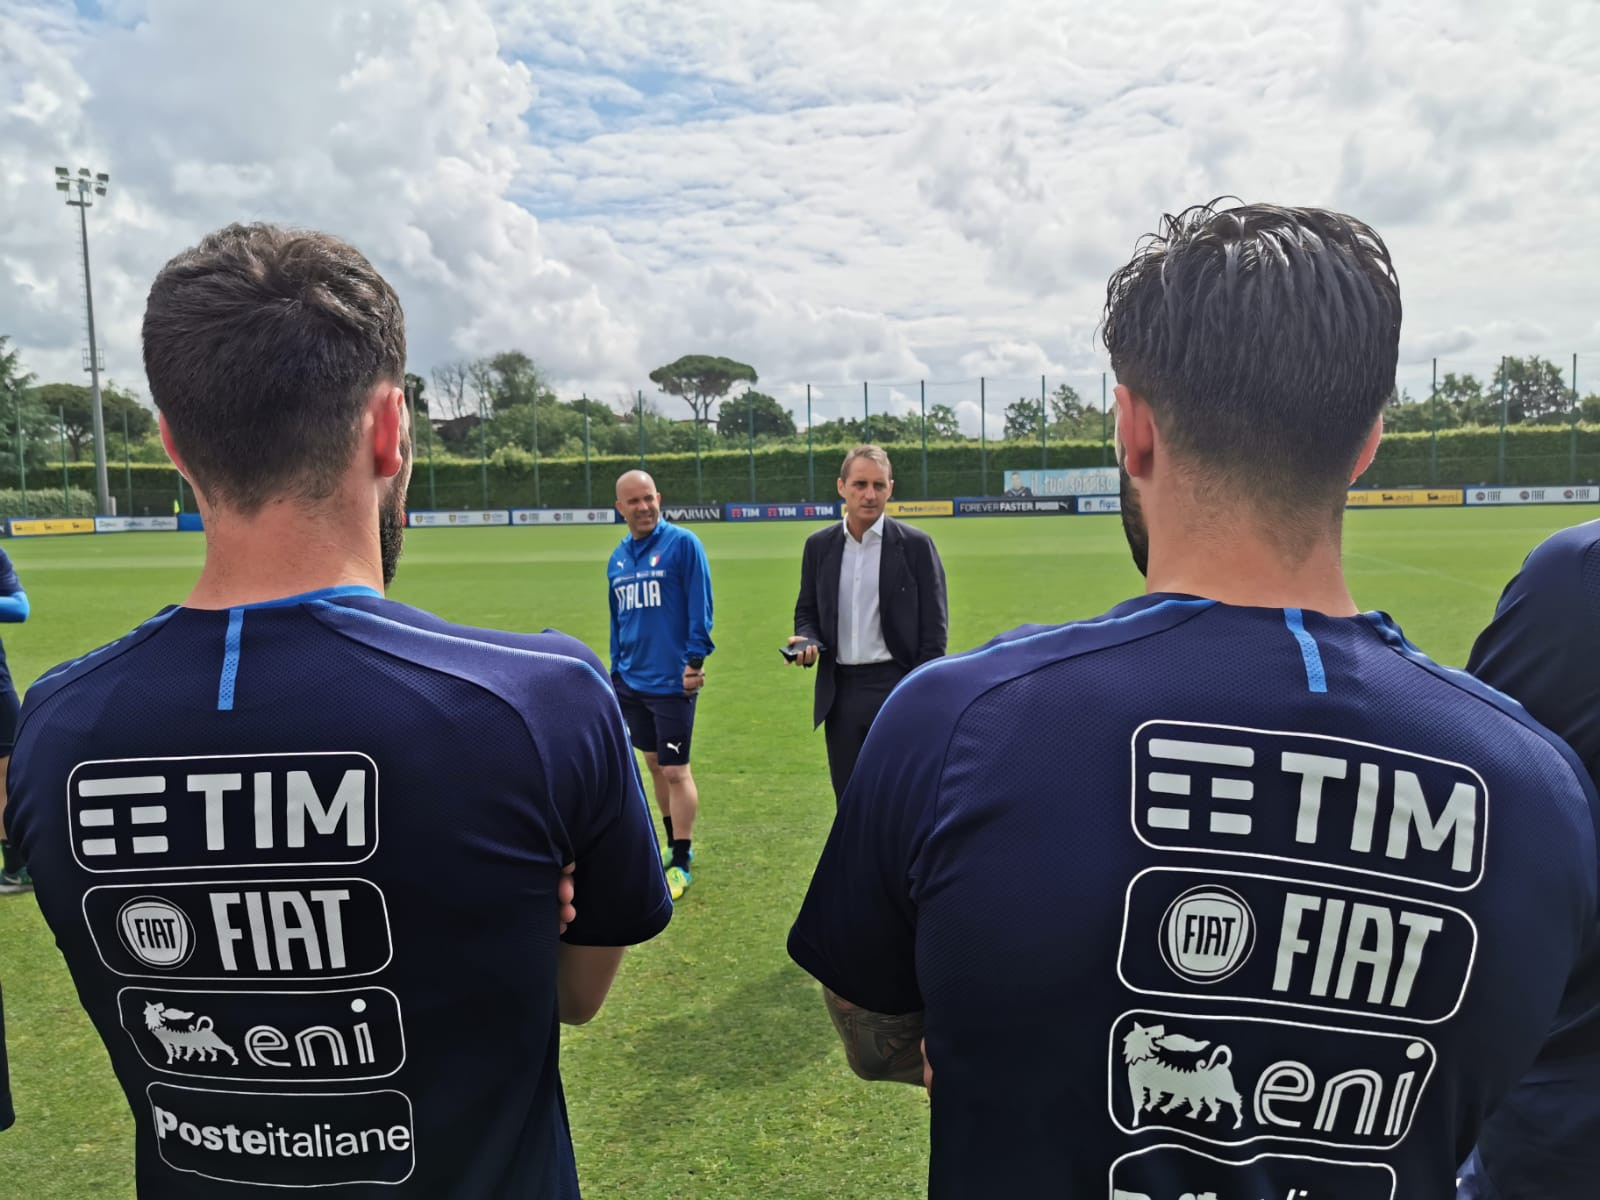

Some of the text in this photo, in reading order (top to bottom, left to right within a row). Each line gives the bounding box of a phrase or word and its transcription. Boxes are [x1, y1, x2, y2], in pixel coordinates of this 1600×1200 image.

[1044, 475, 1064, 494] tuo
[742, 507, 760, 518] TIM
[778, 507, 797, 517] TIM
[814, 506, 834, 516] TIM
[960, 502, 999, 512] FOREVER
[999, 502, 1034, 511] FASTER
[614, 580, 661, 611] ITALIA
[187, 769, 366, 851] TIM
[1281, 751, 1477, 873] TIM
[134, 917, 177, 950] FIAT
[209, 889, 351, 971] FIAT
[1182, 913, 1236, 957] FIAT
[1272, 892, 1443, 1008] FIAT
[244, 998, 376, 1067] eni
[1253, 1041, 1425, 1136] eni
[153, 1104, 411, 1159] Posteitaliane
